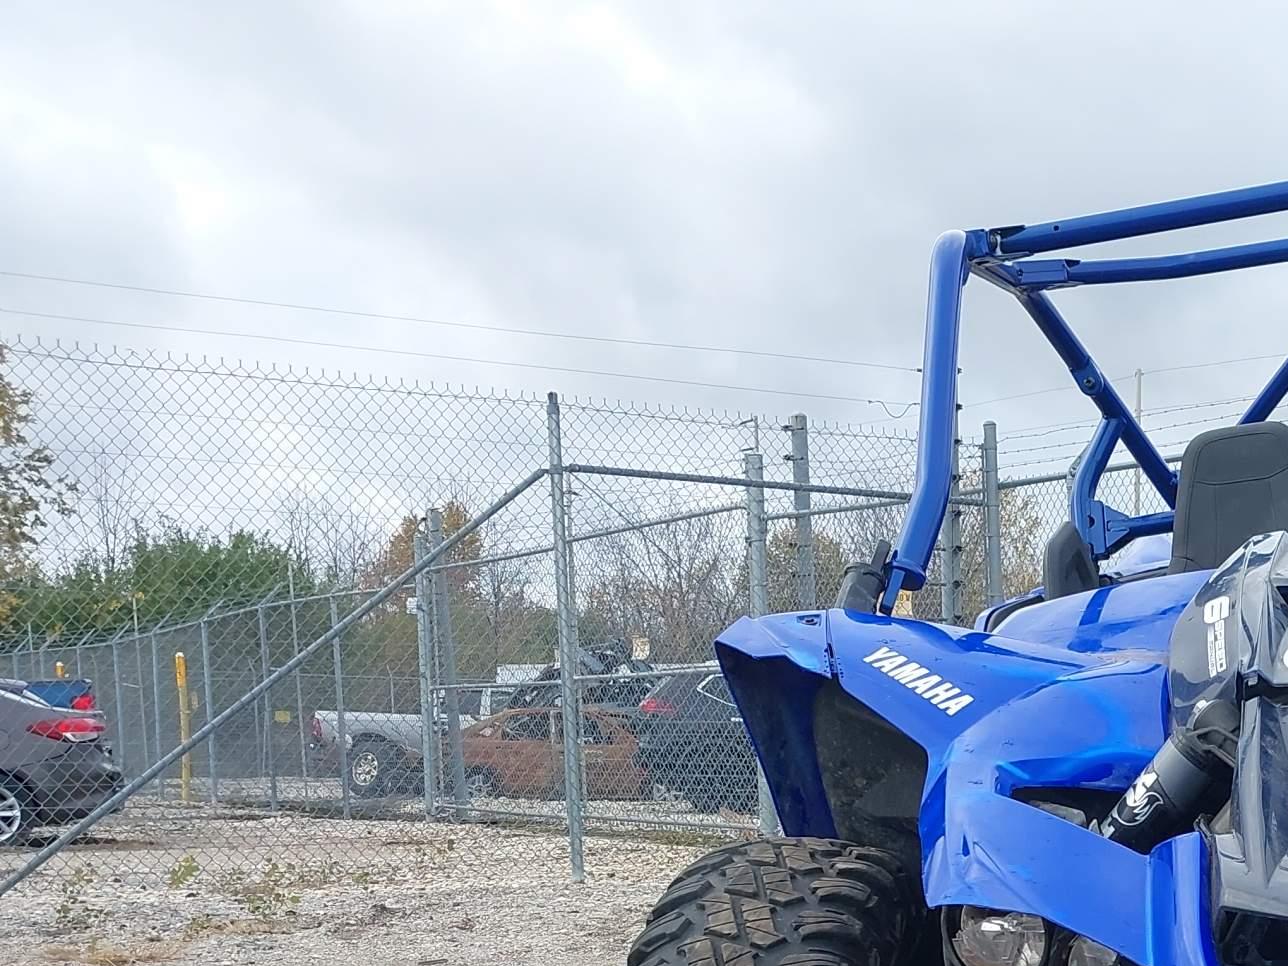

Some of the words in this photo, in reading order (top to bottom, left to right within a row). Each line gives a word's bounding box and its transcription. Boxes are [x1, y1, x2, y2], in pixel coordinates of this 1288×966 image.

[1203, 596, 1230, 625] 6
[1214, 619, 1227, 673] SPEED
[862, 646, 974, 717] YAMAHA
